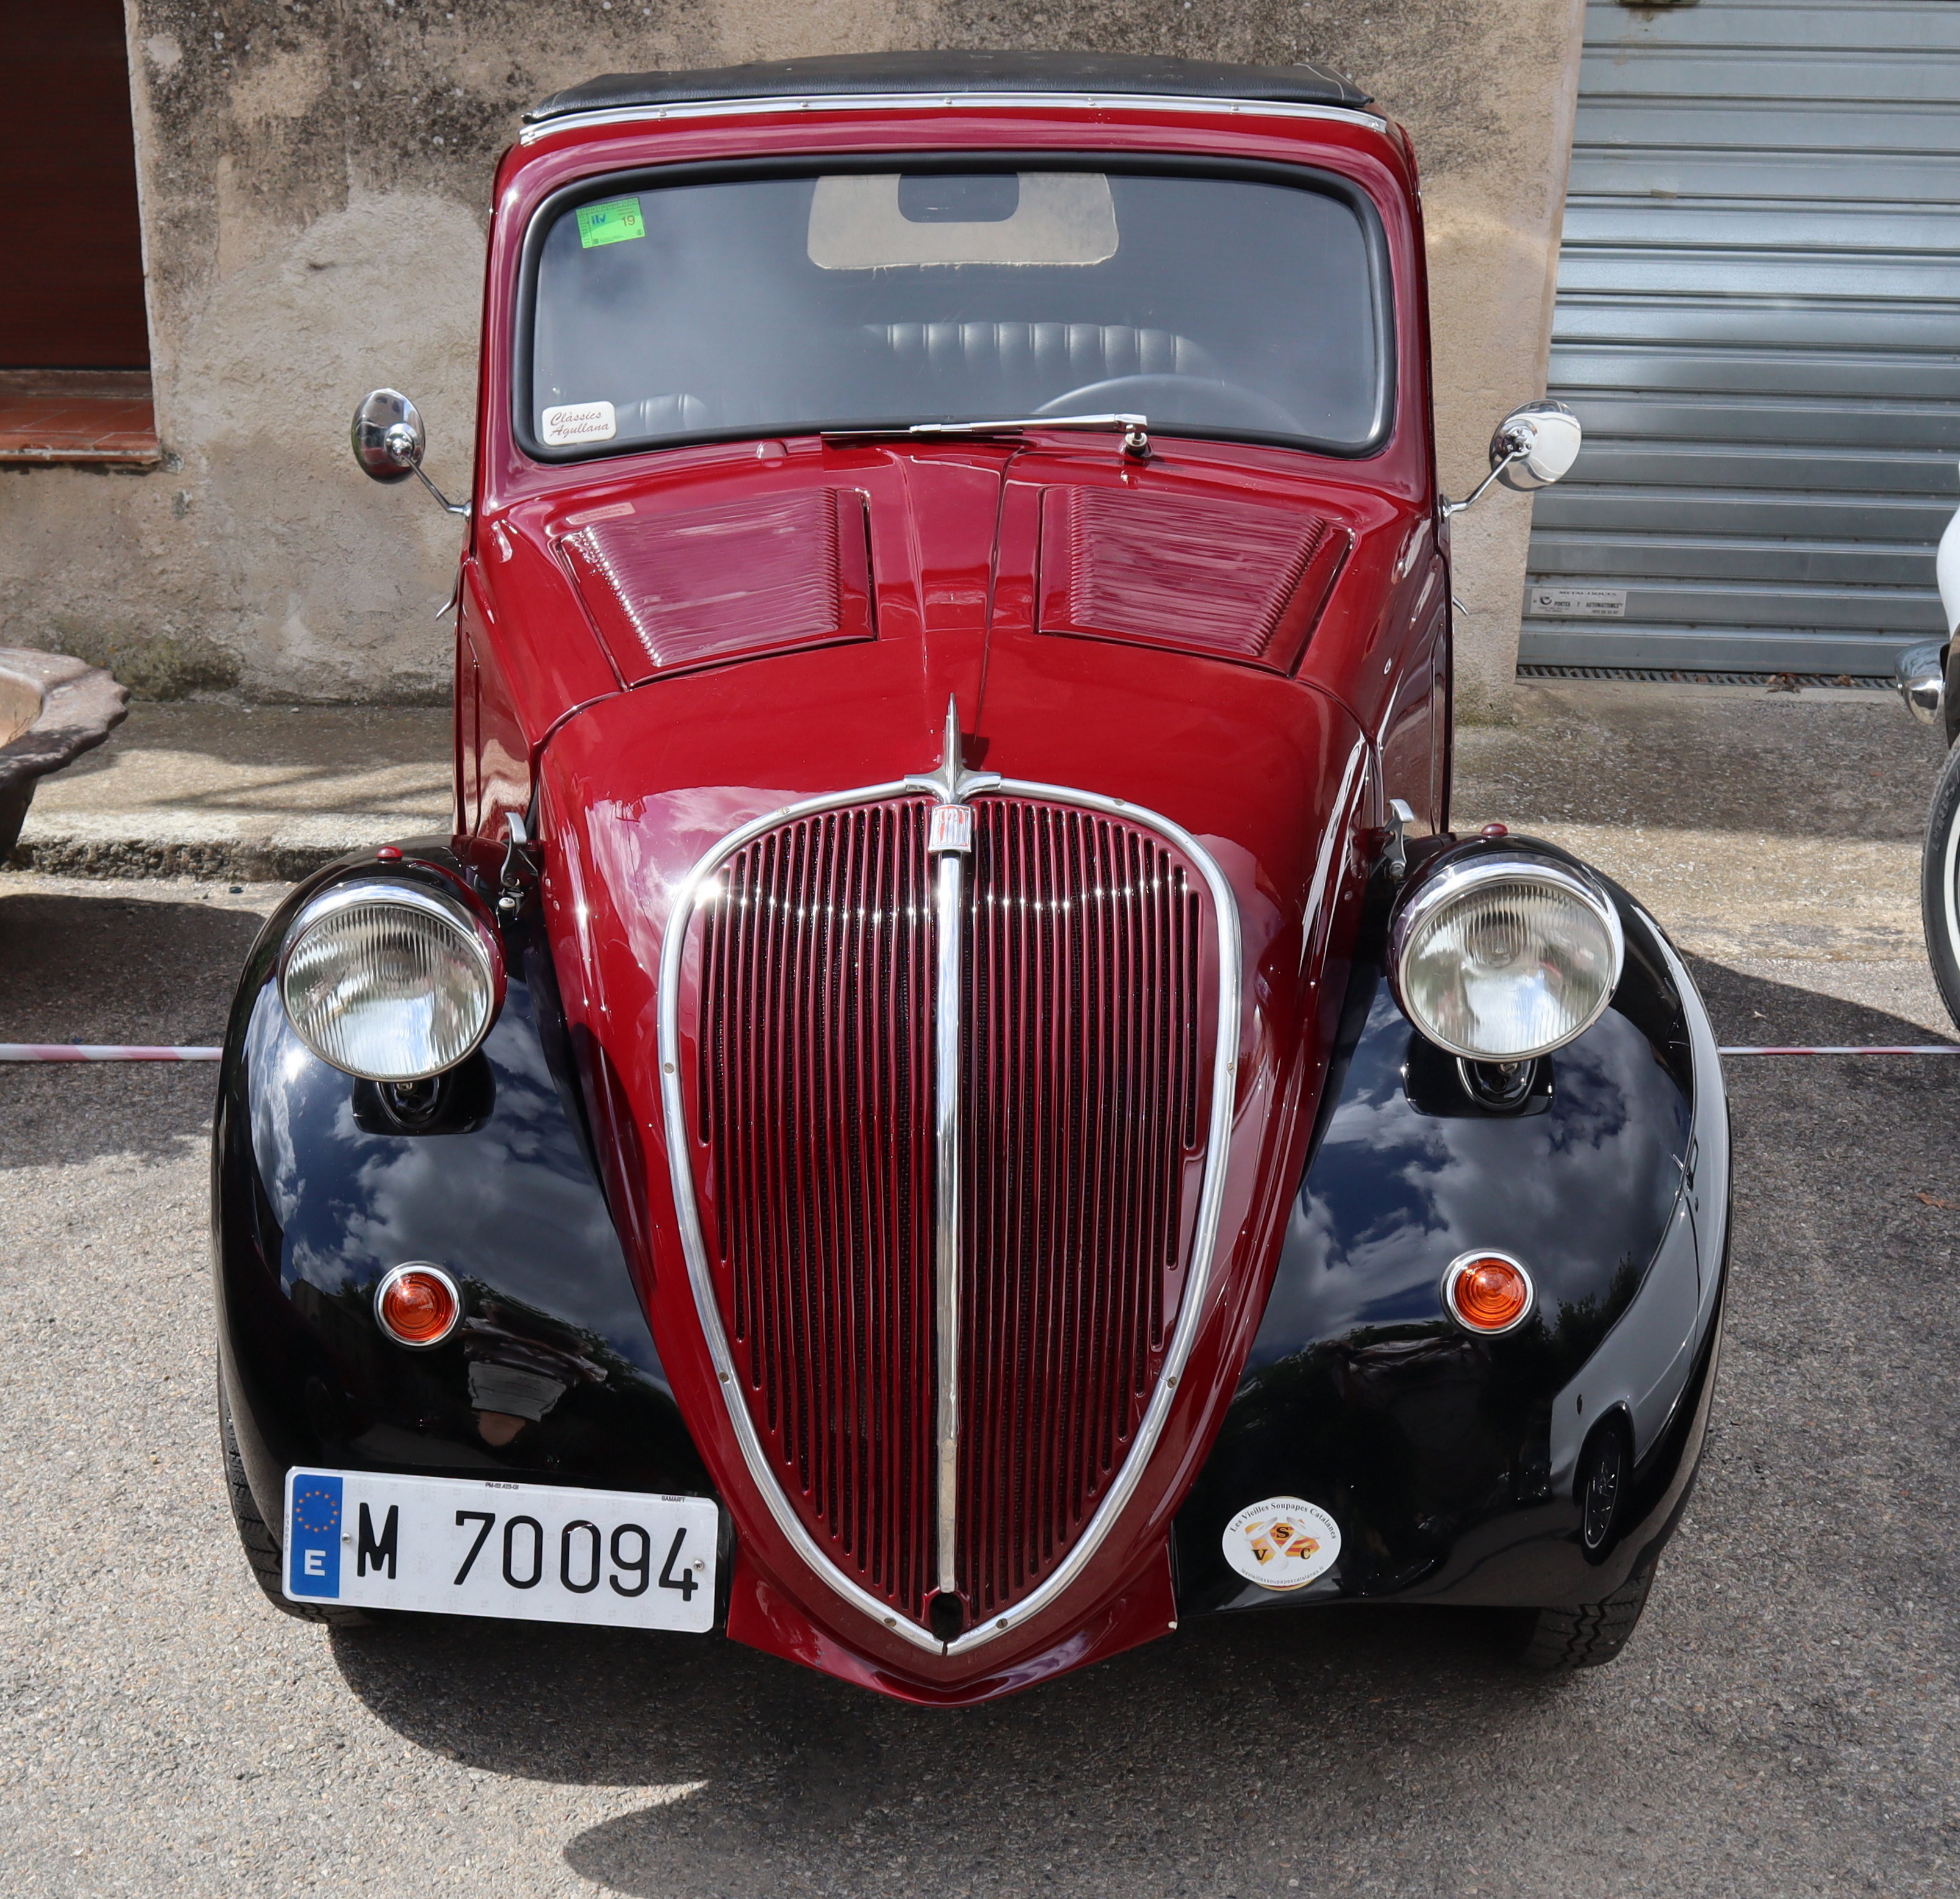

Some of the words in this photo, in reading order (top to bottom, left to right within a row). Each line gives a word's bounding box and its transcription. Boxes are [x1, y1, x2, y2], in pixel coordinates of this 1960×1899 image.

[621, 215, 635, 226] 19
[550, 411, 601, 426] Clàssics
[549, 422, 609, 439] Agullana
[1230, 1520, 1242, 1532] Les
[1241, 1505, 1269, 1519] Vieilles
[1270, 1502, 1308, 1512] Soupapes
[1310, 1508, 1336, 1540] Catalanes
[1276, 1527, 1290, 1538] S
[357, 1502, 398, 1580] M
[453, 1510, 699, 1602] 70094
[1252, 1549, 1267, 1560] V
[1300, 1548, 1311, 1560] C
[304, 1550, 326, 1577] E
